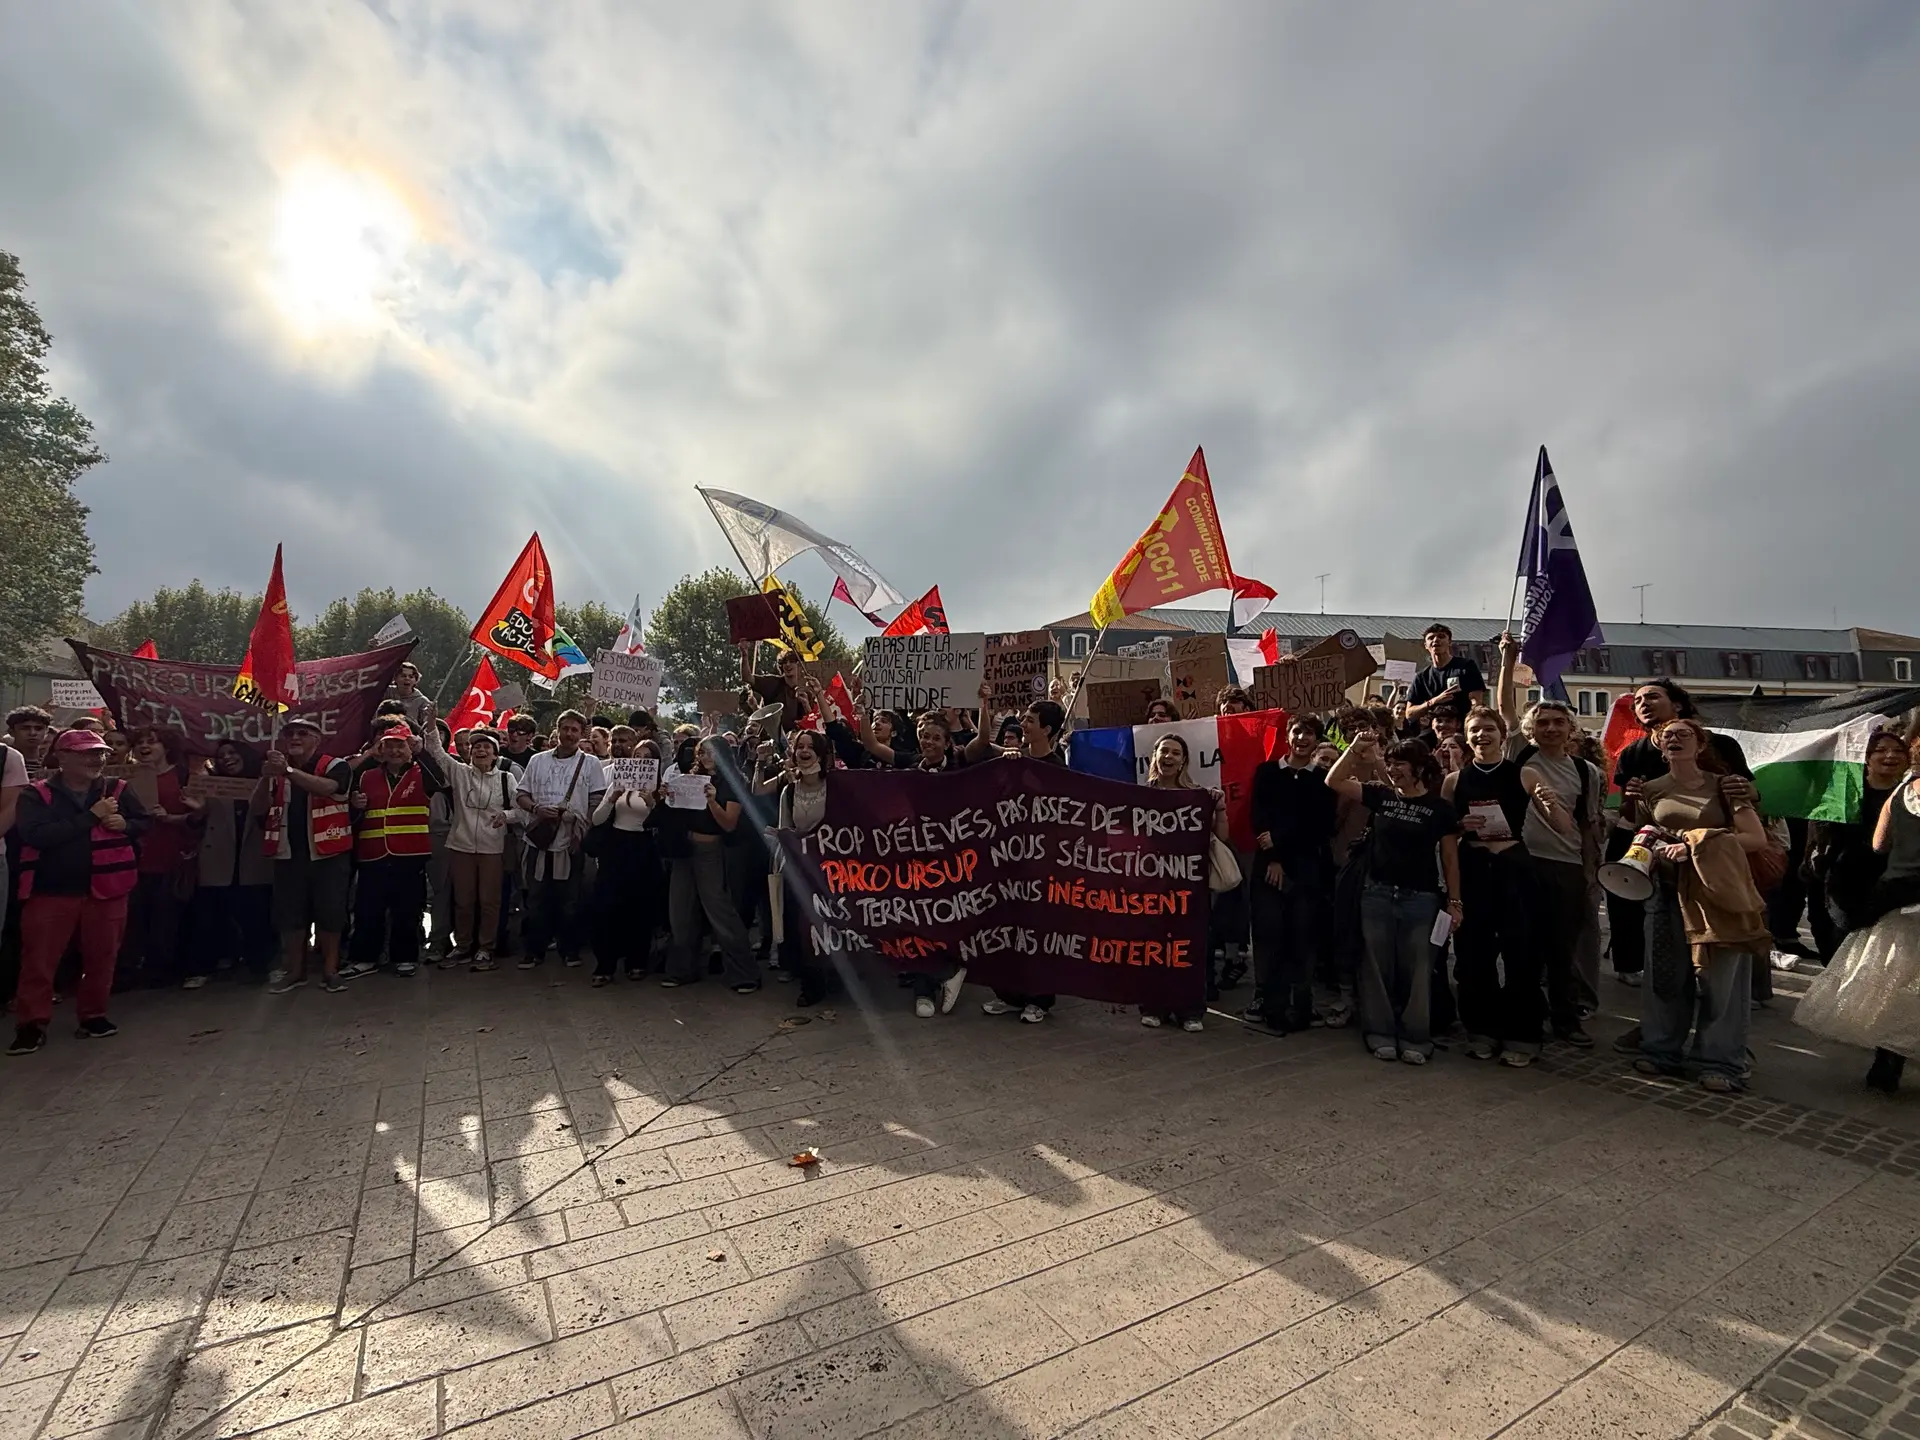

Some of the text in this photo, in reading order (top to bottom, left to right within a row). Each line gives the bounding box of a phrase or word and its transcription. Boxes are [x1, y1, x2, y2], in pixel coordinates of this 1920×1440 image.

[1185, 497, 1223, 580] COMMUNISTE
[1189, 547, 1211, 583] AUDE
[883, 637, 905, 653] PAS
[908, 636, 931, 653] QUE
[934, 635, 951, 652] LA
[596, 651, 615, 665] DES
[616, 654, 646, 670] MOYENS
[864, 654, 902, 668] VEUVE
[906, 654, 922, 670] ET
[86, 653, 379, 700] PARCOUR LASSE
[598, 669, 653, 686] LES CITOYENS
[896, 669, 924, 684] SAIT
[598, 686, 644, 702] DE DEMAIN
[994, 679, 1032, 696] PLUS DE
[1200, 748, 1226, 768] LA
[801, 824, 865, 855] TROP
[996, 794, 1028, 827] PAS
[1031, 796, 1087, 827] ASSEZ
[1091, 803, 1127, 835] DE
[1132, 805, 1203, 836] PROFS
[820, 849, 978, 894] PARCOURSUP
[990, 833, 1046, 867] NOUS
[856, 883, 998, 927] TERRITOIRES
[998, 879, 1042, 902] NOUS
[959, 925, 1014, 961] N'EST
[1043, 932, 1087, 959] UNE
[1089, 933, 1193, 968] LOTERIE
